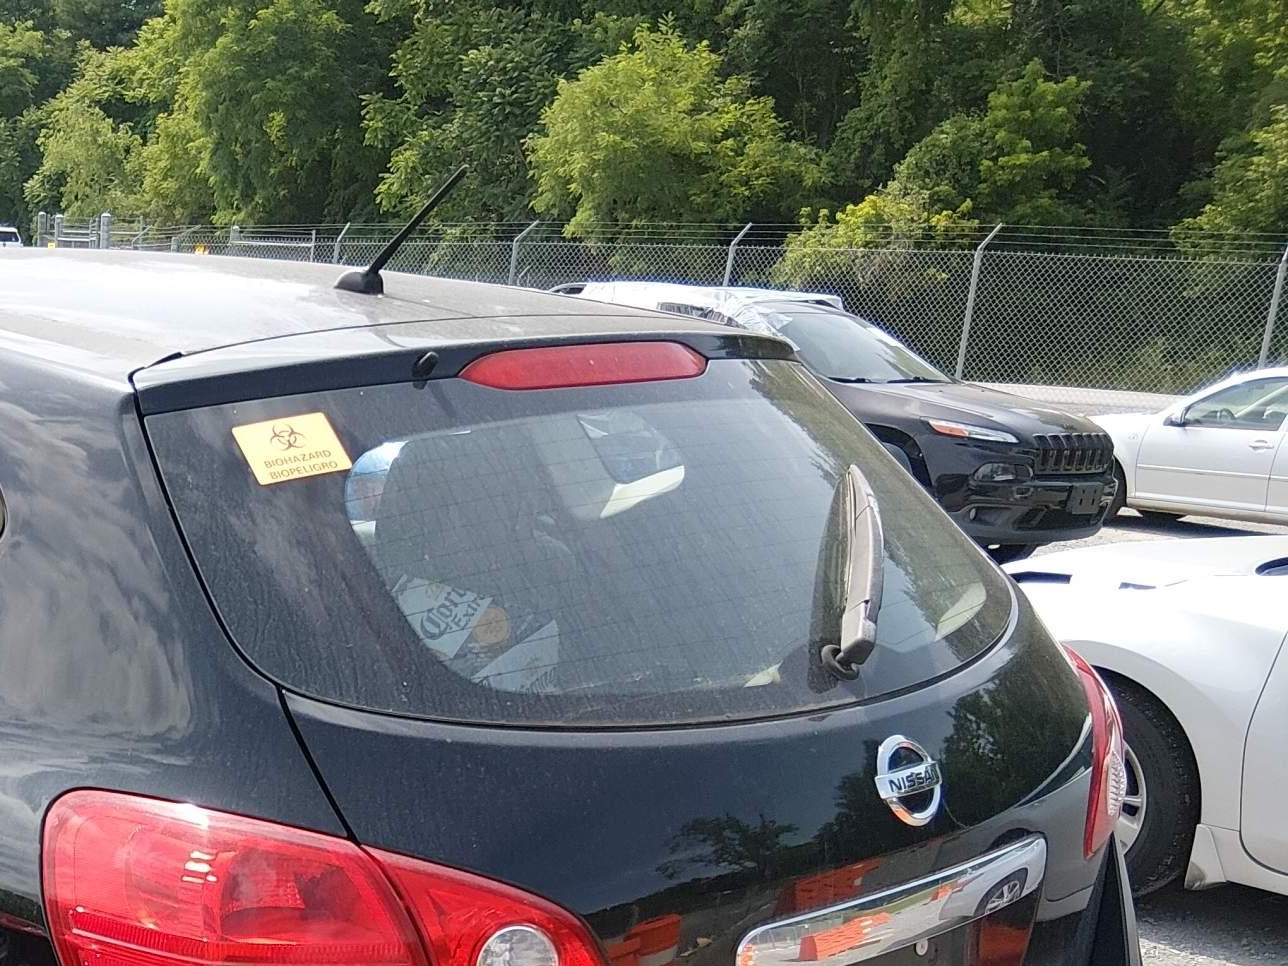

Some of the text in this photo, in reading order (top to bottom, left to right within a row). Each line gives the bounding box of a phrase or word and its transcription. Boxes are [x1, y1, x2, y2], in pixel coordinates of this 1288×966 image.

[264, 449, 332, 469] BIOHAZARD
[270, 460, 338, 480] BIOPELIGRO
[888, 764, 940, 793] NISSAN
